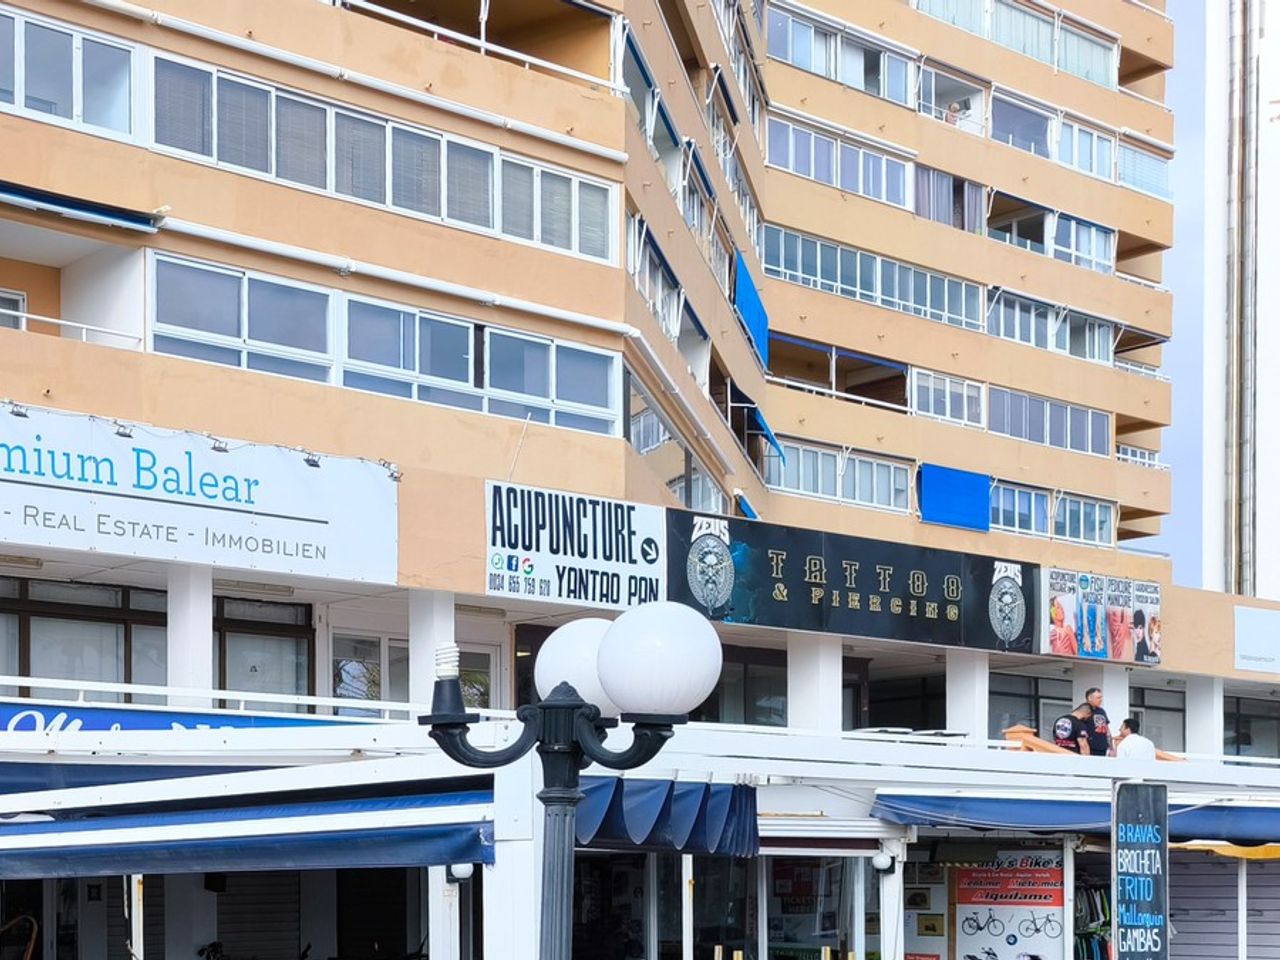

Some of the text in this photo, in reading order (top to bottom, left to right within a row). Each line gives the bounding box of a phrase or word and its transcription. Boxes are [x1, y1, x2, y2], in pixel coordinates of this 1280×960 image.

[131, 445, 261, 506] Balear
[491, 484, 638, 565] ACUPUNCTURE
[691, 516, 730, 546] ZEUS
[555, 565, 659, 606] YANTAO PAN
[768, 549, 963, 601] TATTOO
[992, 560, 1022, 587] ZEUS
[772, 582, 960, 622] & PIERCING
[1119, 823, 1161, 844] BRAVAS
[1118, 849, 1162, 875] BROCHETA
[1118, 876, 1153, 901] FRITO
[1119, 928, 1161, 952] GAMBAS
